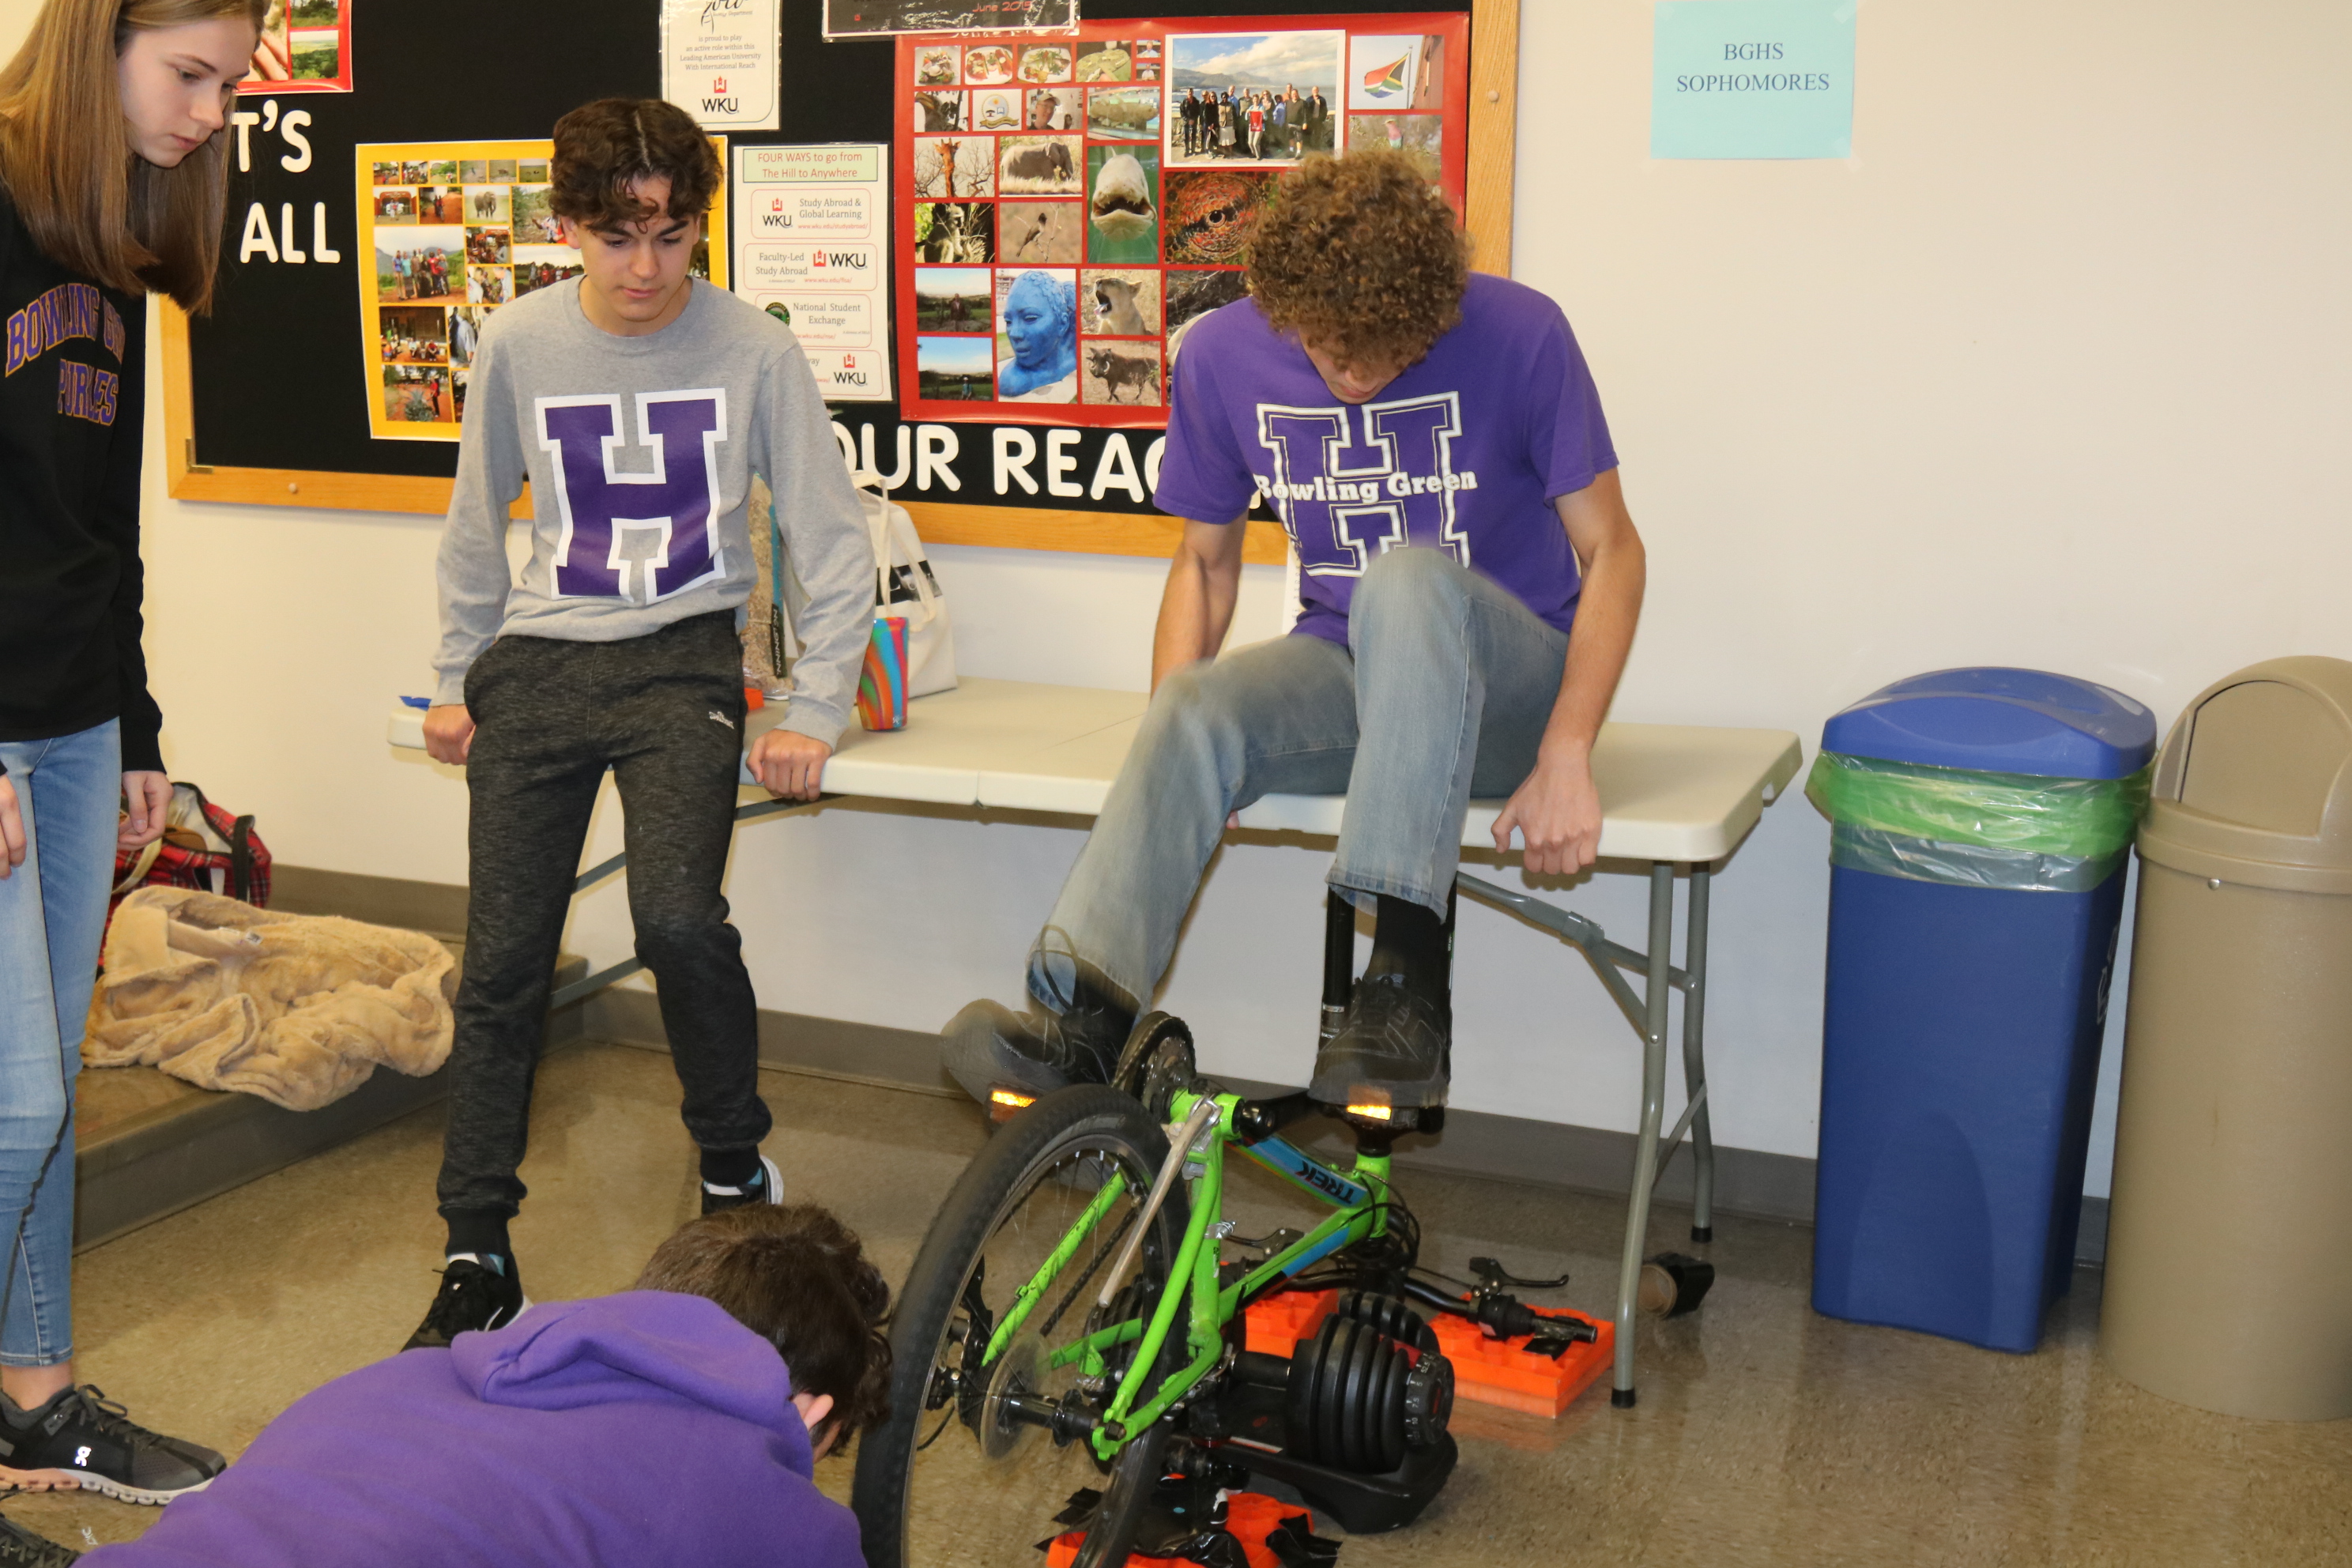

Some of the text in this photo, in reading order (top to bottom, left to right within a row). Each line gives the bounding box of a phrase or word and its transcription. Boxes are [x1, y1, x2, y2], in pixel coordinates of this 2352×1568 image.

[972, 2, 998, 13] June
[1723, 42, 1785, 61] BGHS
[1676, 73, 1830, 92] SOPHOMORES
[702, 97, 739, 115] WKU
[231, 99, 313, 174] T'S
[758, 152, 862, 164] FOUR WAYS to go from
[762, 167, 858, 180] The Hill to Anywhere
[799, 198, 861, 209] Study Abroad &
[762, 215, 793, 229] WKU
[799, 209, 862, 220] Global Learning
[239, 202, 341, 264] ALL
[759, 252, 805, 262] Faculty-Led
[829, 253, 867, 270] WKU
[755, 266, 808, 277] Study Abroad
[793, 302, 861, 312] National Student
[808, 315, 846, 326] Exchange
[833, 371, 867, 387] WKU
[58, 358, 119, 427] PURES
[831, 420, 1262, 510] UR REA
[1253, 469, 1479, 504] Bowling Green
[534, 387, 729, 605] H
[1295, 1159, 1355, 1205] TREK
